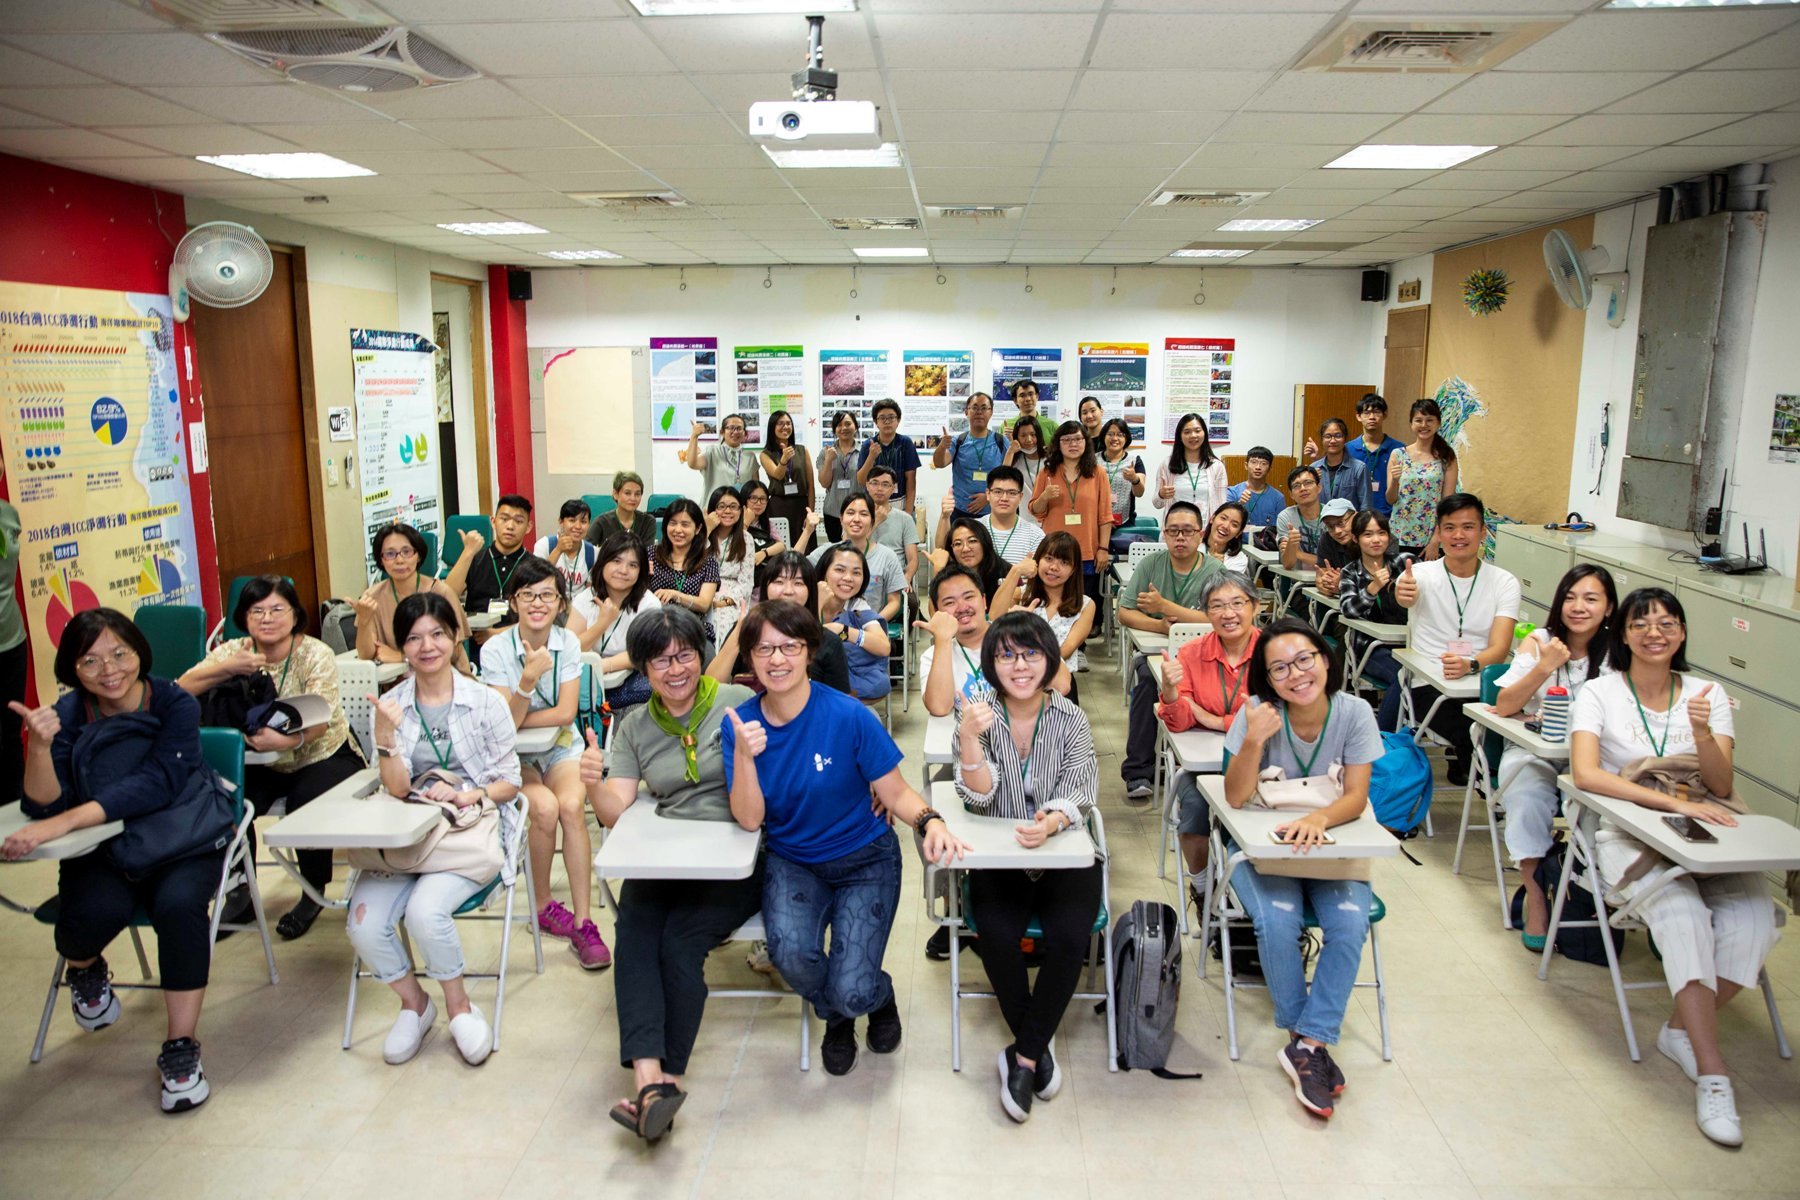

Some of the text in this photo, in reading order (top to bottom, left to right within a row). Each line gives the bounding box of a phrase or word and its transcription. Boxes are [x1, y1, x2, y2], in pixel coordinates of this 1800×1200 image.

[27, 513, 127, 543] 2018台灣ICC淨灘行動
[55, 544, 78, 559] 依材質
[39, 562, 56, 573] 1.4%
[68, 568, 84, 578] 1.2%
[31, 587, 49, 599] 6.4%
